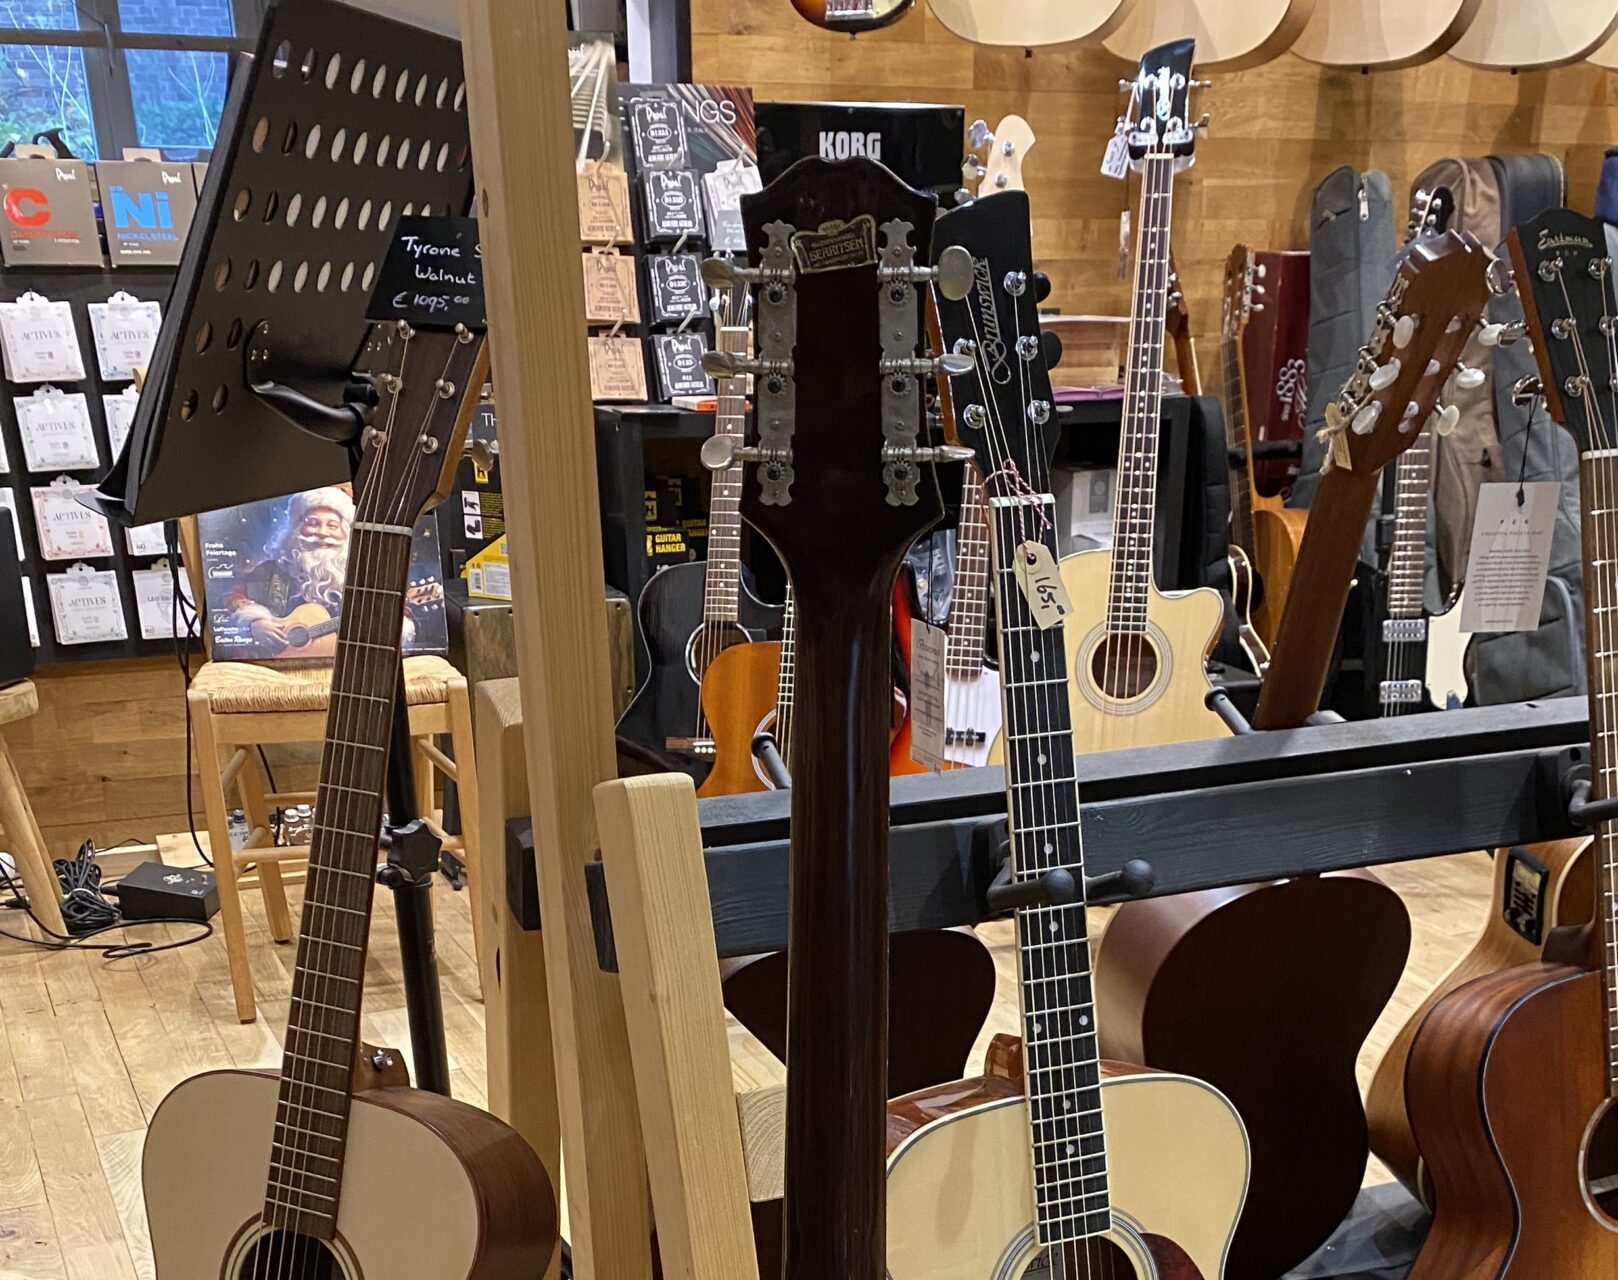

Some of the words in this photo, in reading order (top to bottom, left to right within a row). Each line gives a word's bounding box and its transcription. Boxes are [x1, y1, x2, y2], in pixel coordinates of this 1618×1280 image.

[818, 131, 881, 160] KORG
[110, 190, 174, 229] Ni
[401, 236, 461, 259] Tyrone
[1538, 228, 1594, 250] Eastman
[415, 264, 476, 284] Walnut
[972, 256, 1012, 385] Brunswick
[655, 533, 682, 543] GUITAR
[655, 543, 686, 553] HANGER
